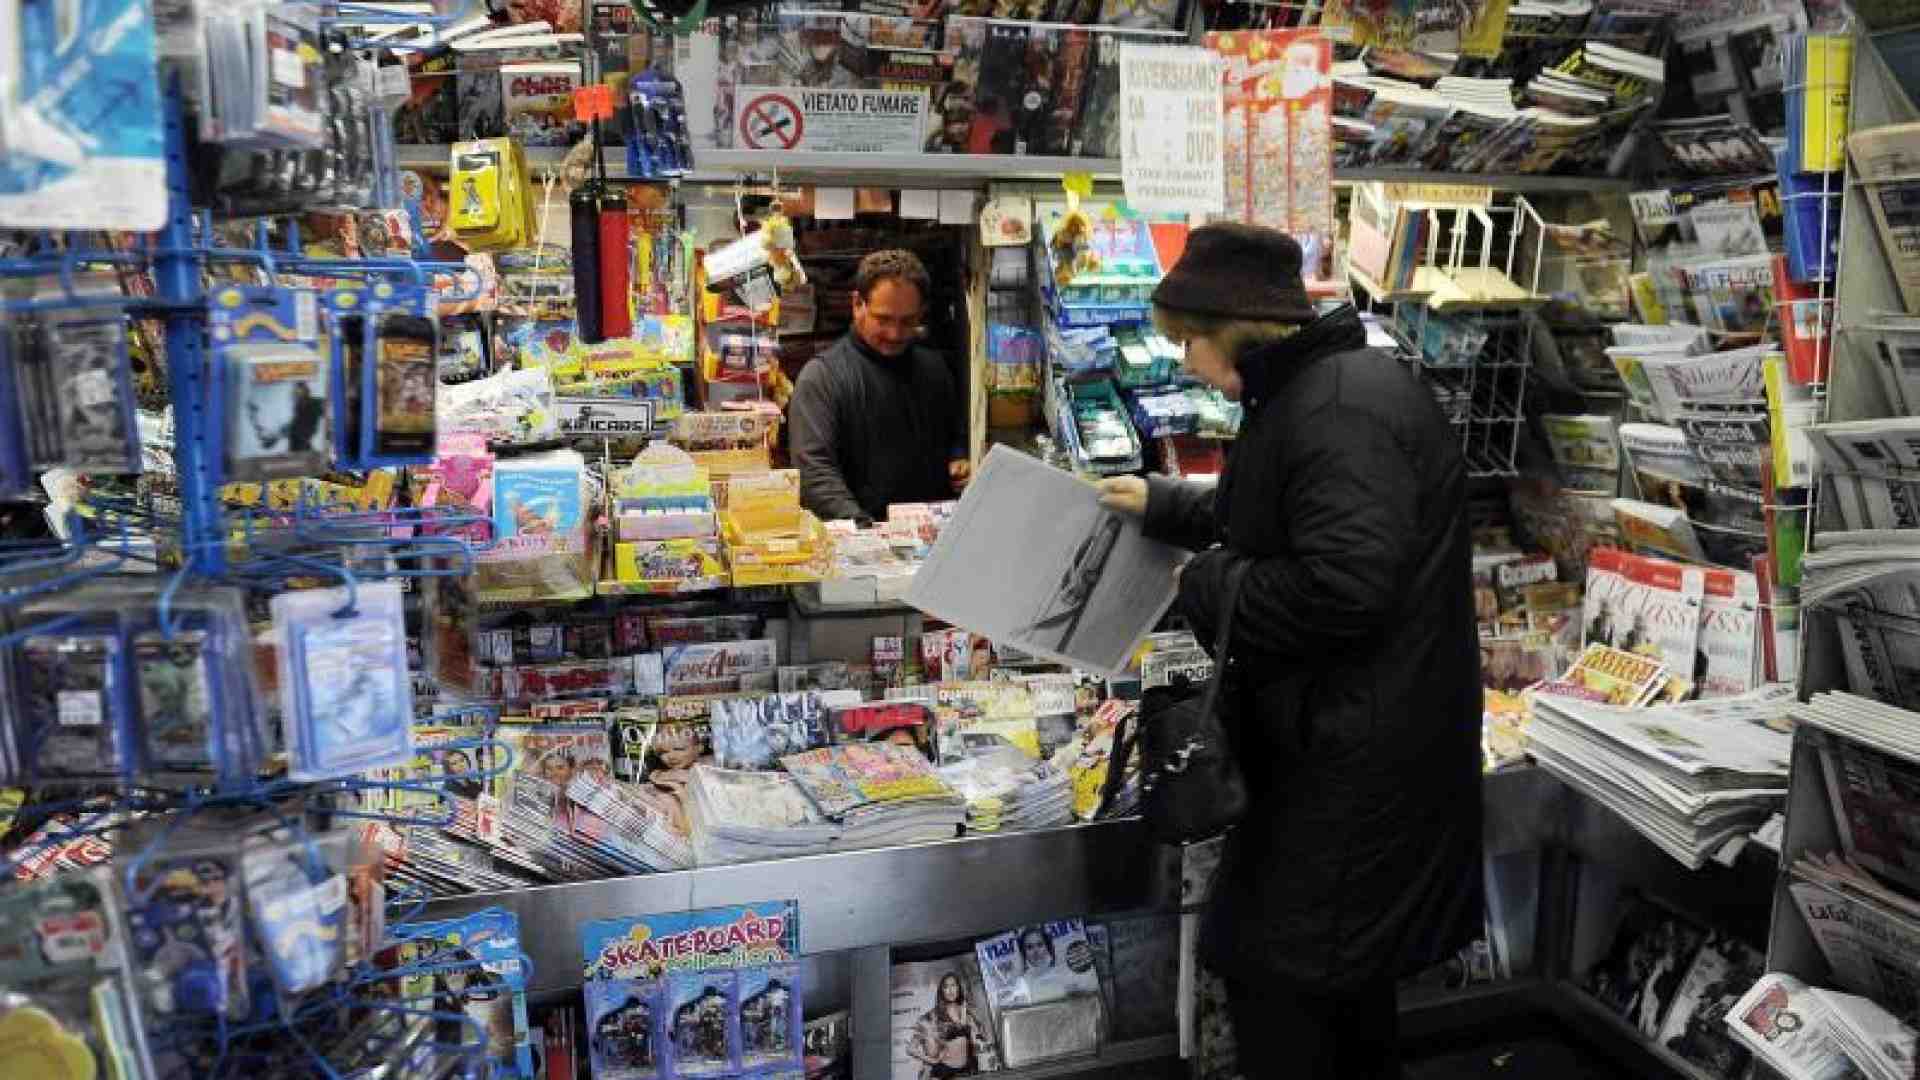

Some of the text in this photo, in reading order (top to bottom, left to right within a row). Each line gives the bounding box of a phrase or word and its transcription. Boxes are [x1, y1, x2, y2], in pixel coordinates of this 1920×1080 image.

[1127, 61, 1218, 91] RIVERSIAMO
[802, 92, 919, 114] VIETATO FUMARE
[1186, 132, 1217, 162] DVD
[602, 918, 783, 968] SKATEBOARD
